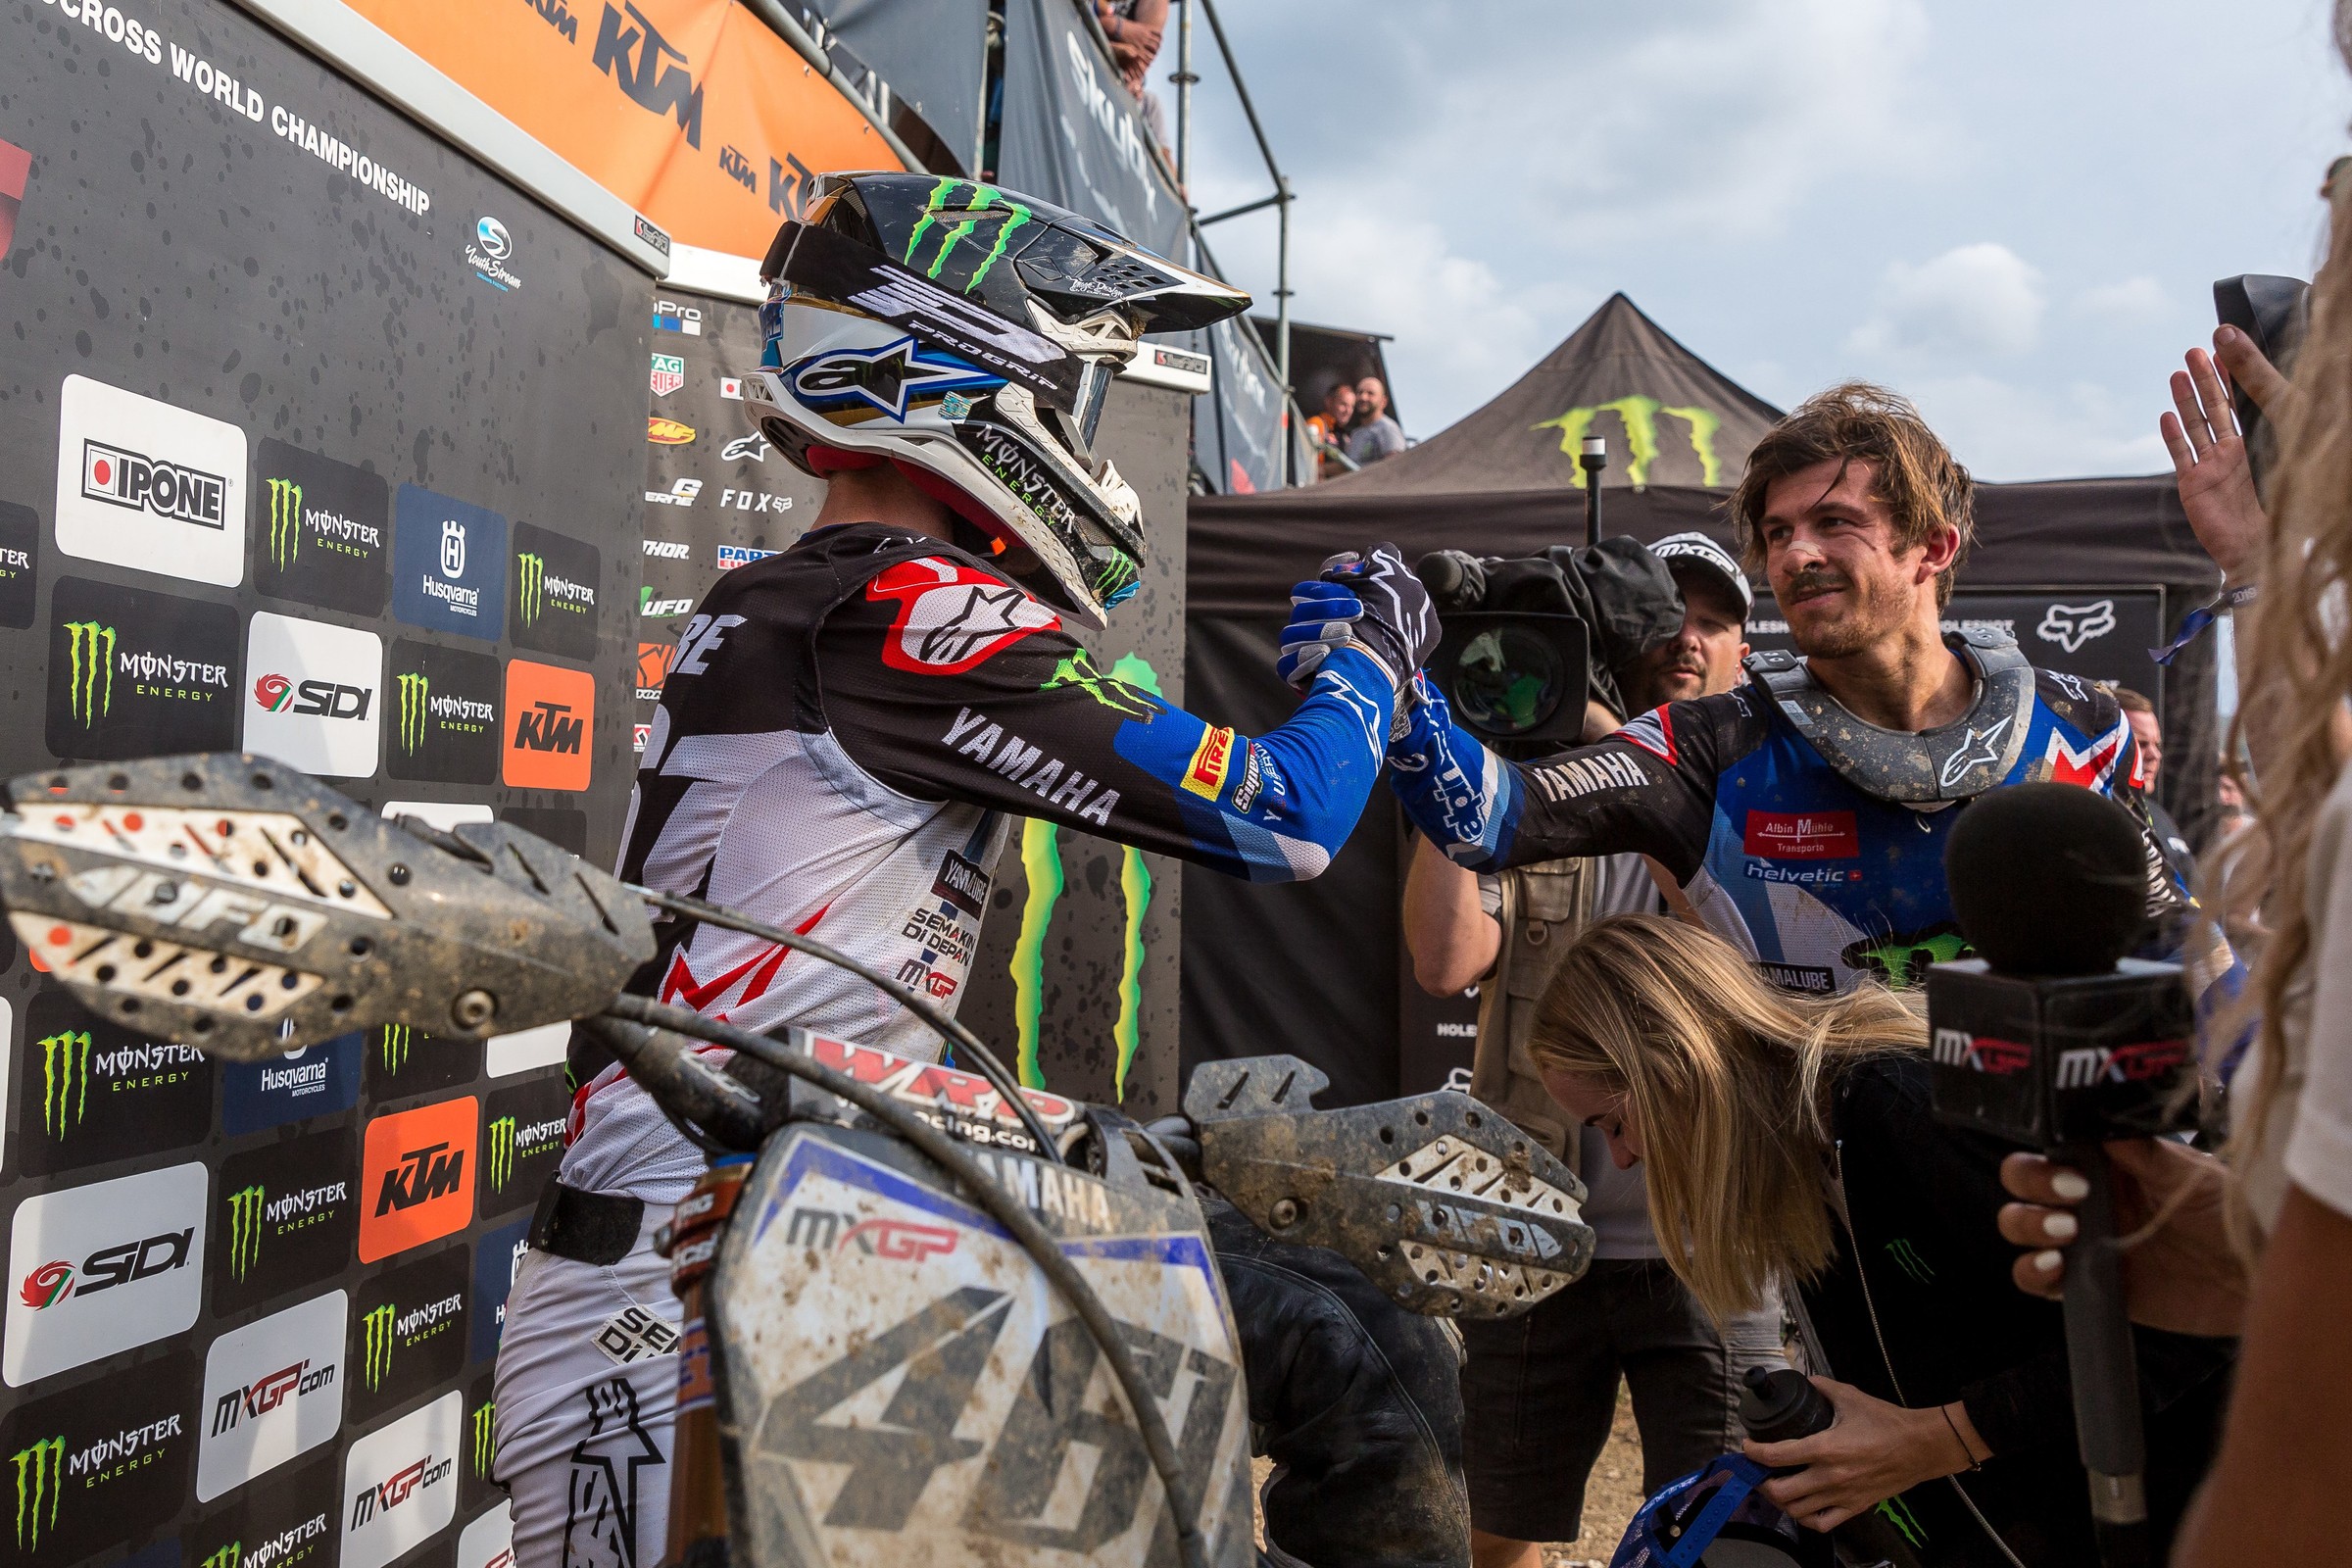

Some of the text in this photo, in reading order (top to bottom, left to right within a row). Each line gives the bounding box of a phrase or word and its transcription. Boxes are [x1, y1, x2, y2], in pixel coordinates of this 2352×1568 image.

[592, 0, 704, 151] KTM
[42, 0, 431, 217] CROSS WORLD CHAMPIONSHIP
[718, 144, 757, 195] KTM
[768, 151, 816, 223] KT
[654, 300, 703, 320] Pro
[649, 422, 696, 440] MF
[116, 455, 225, 529] IPONE
[976, 423, 1076, 534] MONSTER
[982, 454, 1055, 527] ENERGY
[720, 488, 772, 513] FOX
[305, 508, 381, 549] MONSTER
[317, 538, 369, 559] ENERGY
[422, 574, 480, 607] Husqvarna
[544, 575, 595, 606] MONSTER
[551, 599, 587, 615] ENERGY
[642, 599, 693, 616] UFO
[120, 651, 228, 688] MONSTER
[136, 684, 213, 702] ENERGY
[430, 694, 494, 722] MONSTER
[441, 720, 485, 734] ENERGY
[514, 701, 584, 755] KTM
[941, 706, 1121, 827] YAMAHA
[1531, 751, 1650, 803] YAMAHA
[1765, 821, 1793, 834] Albin
[1747, 862, 1844, 882] helvetic
[902, 923, 972, 967] DI DEPAN
[911, 907, 977, 952] SEMAKIN
[1760, 965, 1831, 991] AMALUBE
[113, 1071, 189, 1093] ENERGY
[261, 1058, 328, 1092] Husqvarna
[515, 1117, 566, 1148] MONSTER
[522, 1140, 560, 1158] ENERGY
[374, 1141, 465, 1218] KTM
[267, 1181, 348, 1222] MONSTER
[277, 1209, 335, 1235] ENERGY
[396, 1293, 463, 1337] MONSTER
[406, 1320, 452, 1348] ENERGY
[70, 1413, 182, 1476] MONSTER
[86, 1448, 166, 1489] ENERGY
